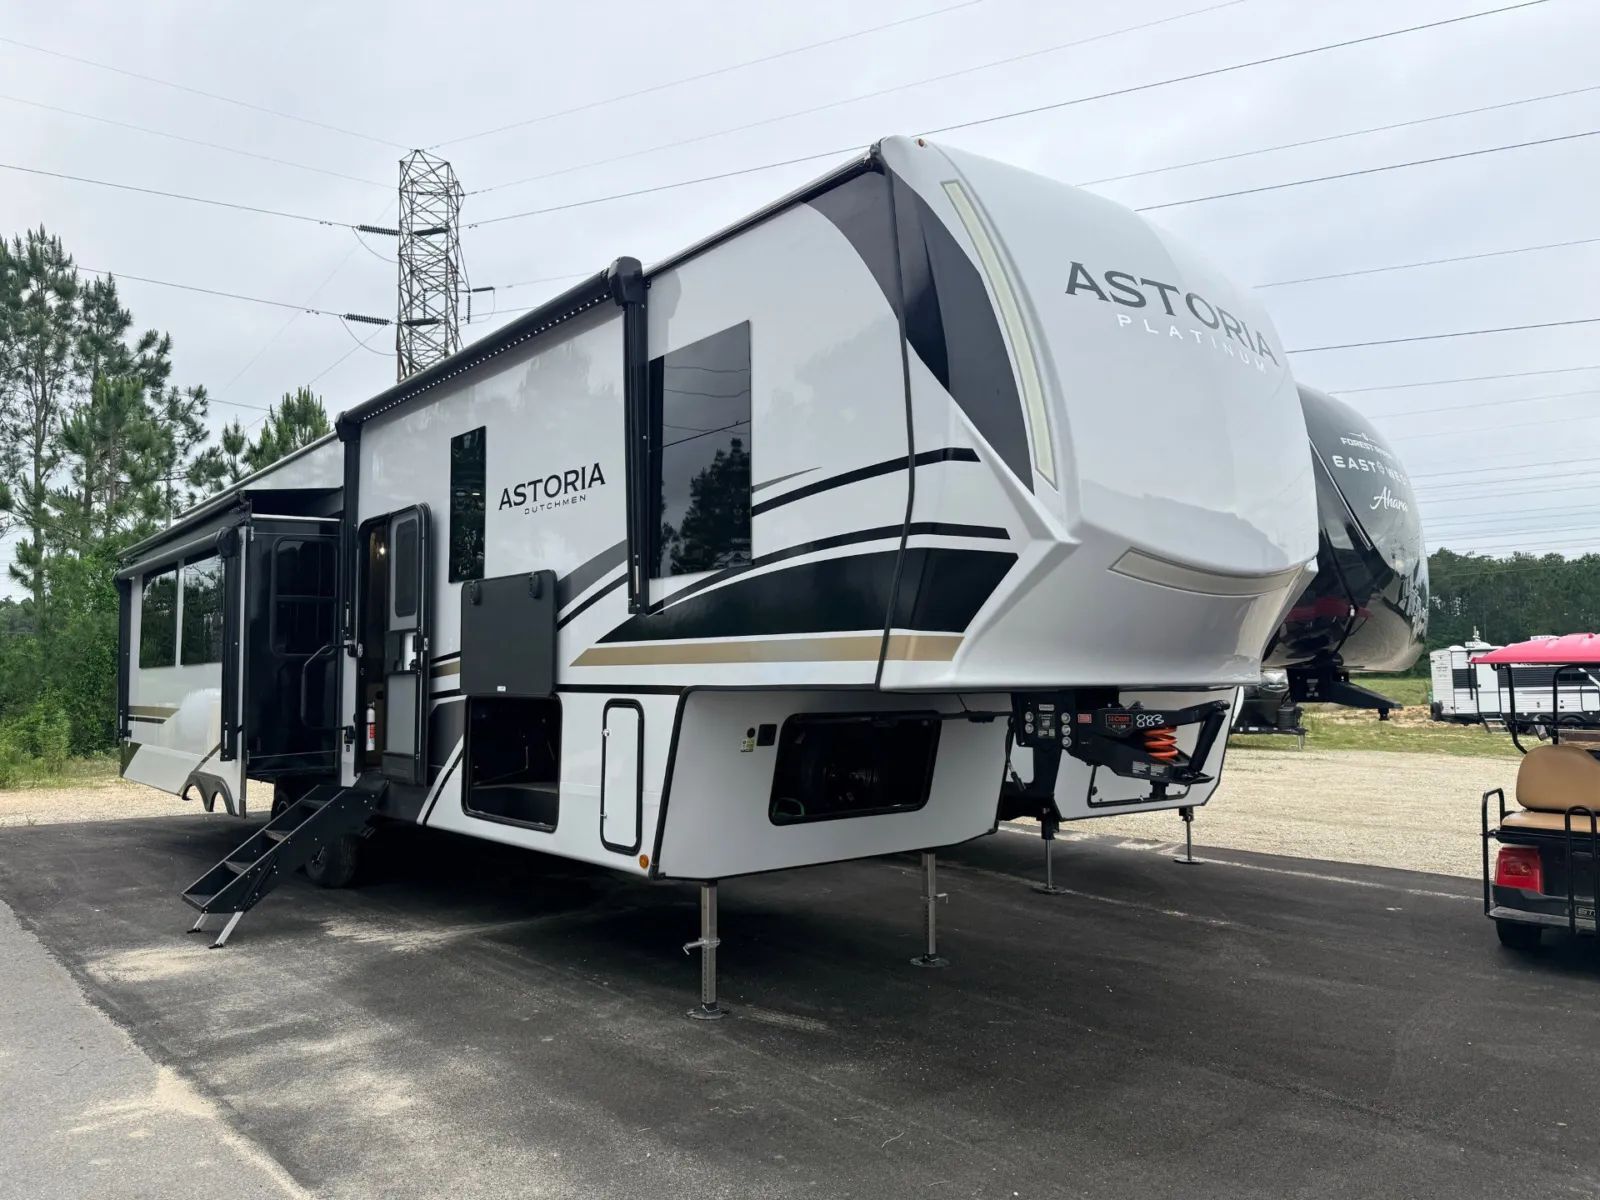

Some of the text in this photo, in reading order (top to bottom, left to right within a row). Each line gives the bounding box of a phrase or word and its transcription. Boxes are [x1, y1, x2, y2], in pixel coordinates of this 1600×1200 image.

[1064, 260, 1281, 367] ASTORIA
[1116, 313, 1267, 374] PLATINUM
[1332, 455, 1376, 473] EAST
[498, 462, 606, 511] ASTORIA
[524, 494, 586, 515] DUTCHMEN
[1136, 713, 1165, 728] 883
